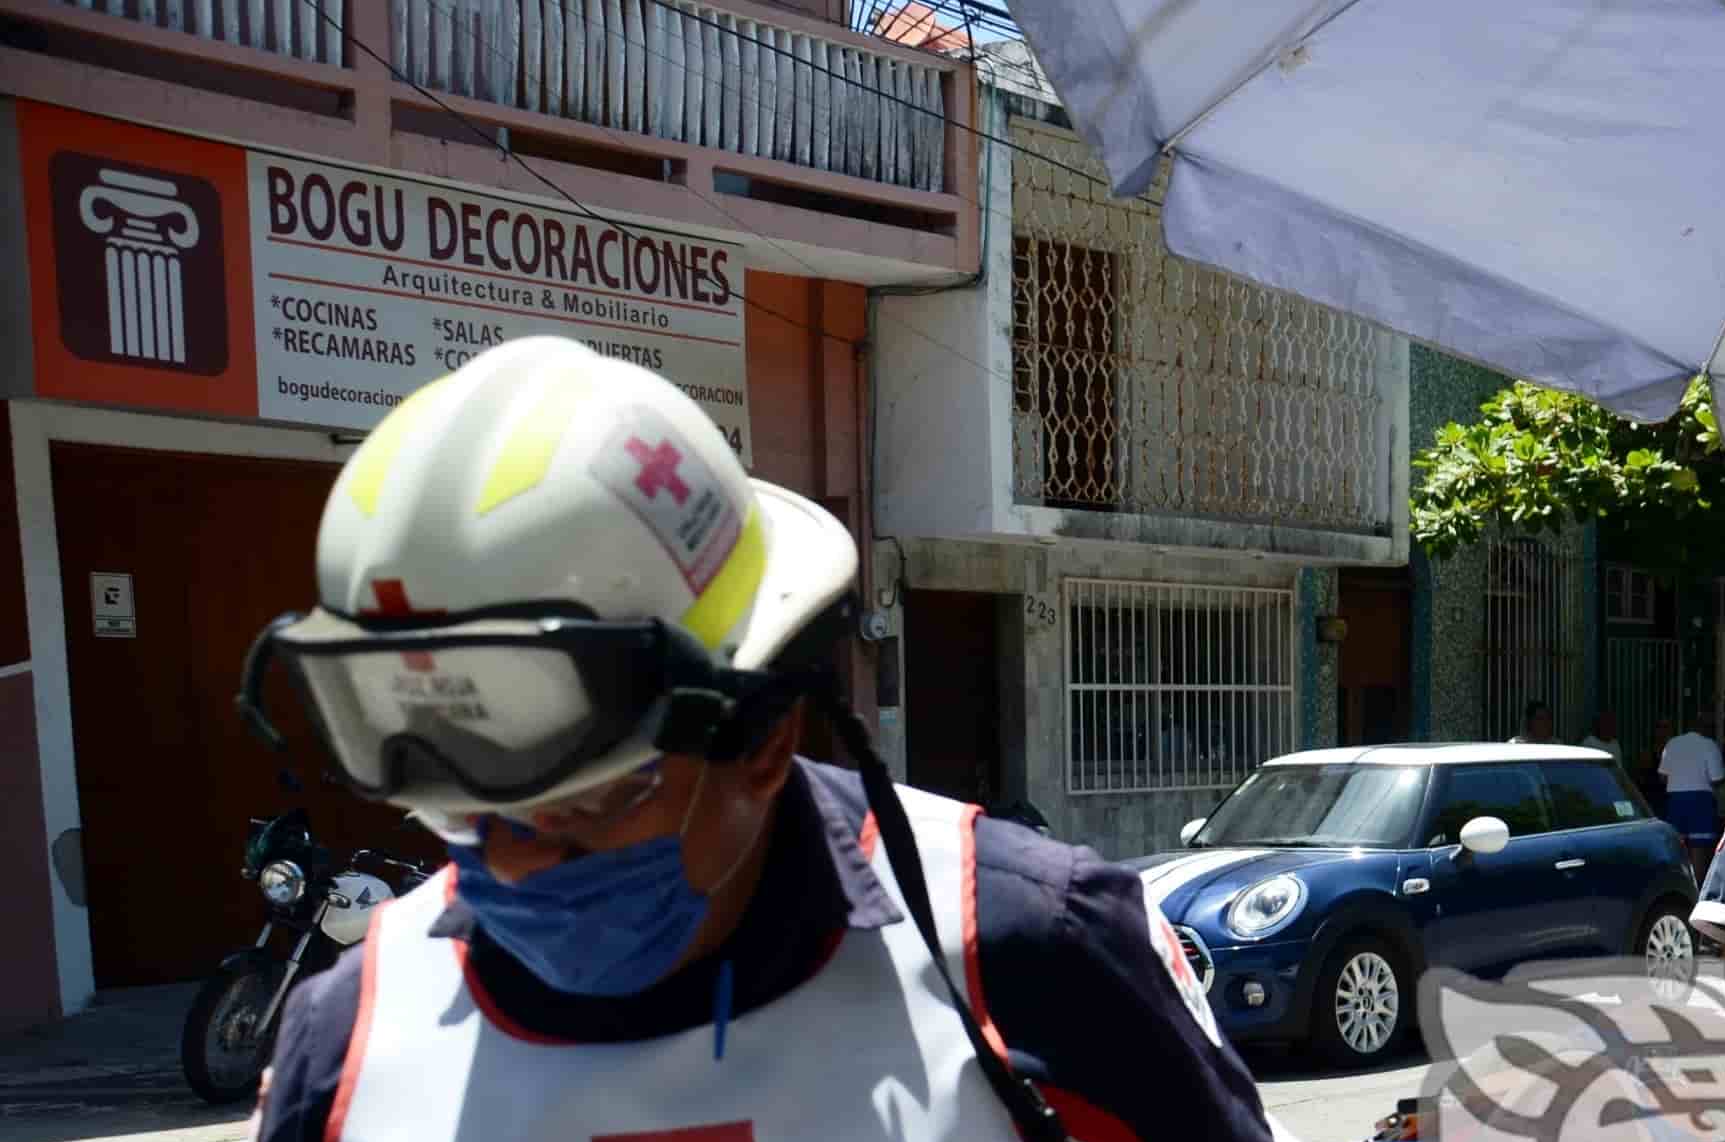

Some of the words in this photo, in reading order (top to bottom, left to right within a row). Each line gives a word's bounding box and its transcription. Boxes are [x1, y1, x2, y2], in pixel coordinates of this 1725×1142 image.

[267, 166, 406, 252] BOGU
[428, 196, 731, 306] DECORACIONES
[382, 264, 535, 308] Arquitectura
[542, 288, 562, 310] &
[563, 293, 670, 329] Mobiliario
[1027, 594, 1057, 625] 223
